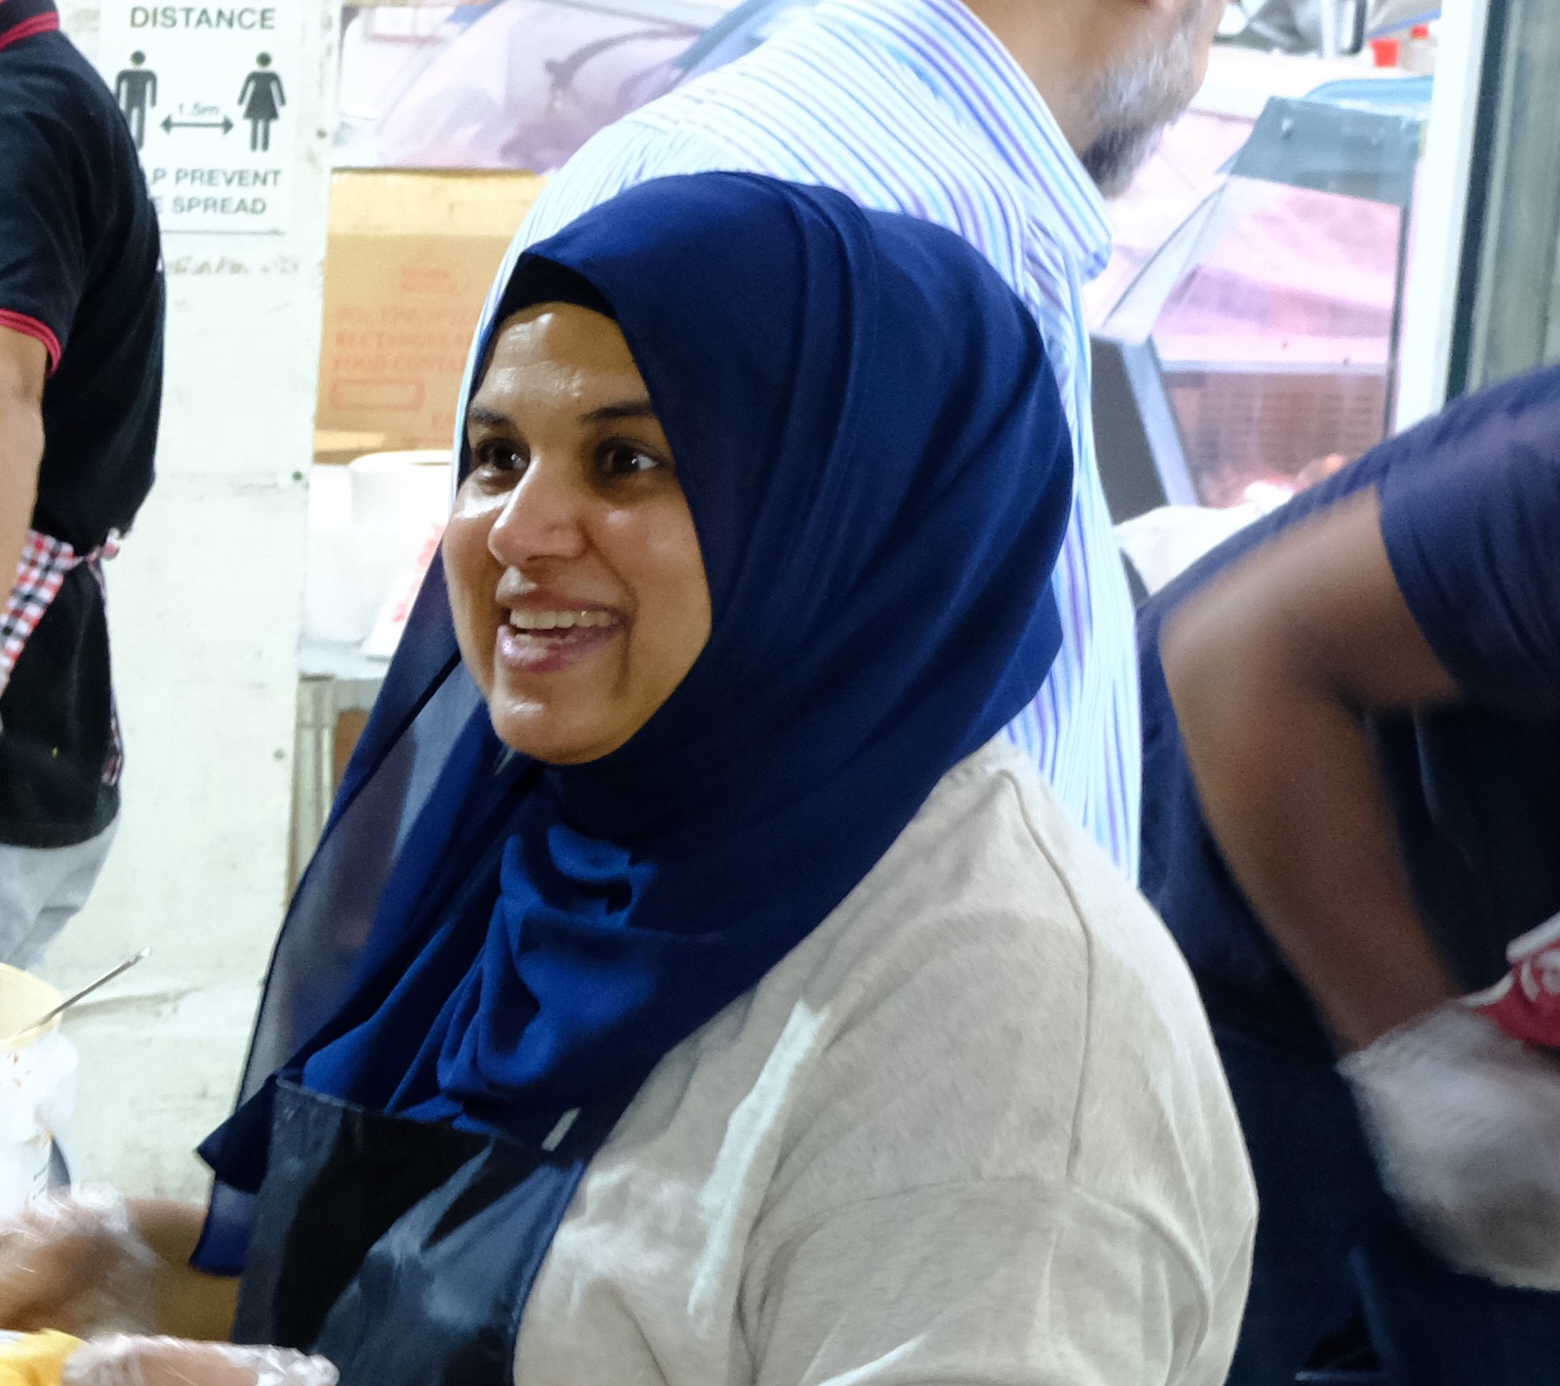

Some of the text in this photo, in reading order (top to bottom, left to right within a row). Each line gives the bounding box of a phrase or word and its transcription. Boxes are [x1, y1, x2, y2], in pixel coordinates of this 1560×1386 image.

[130, 6, 277, 30] DISTANCE
[177, 103, 220, 117] 1.5m
[174, 169, 282, 188] PREVENT
[171, 196, 267, 216] SPREAD
